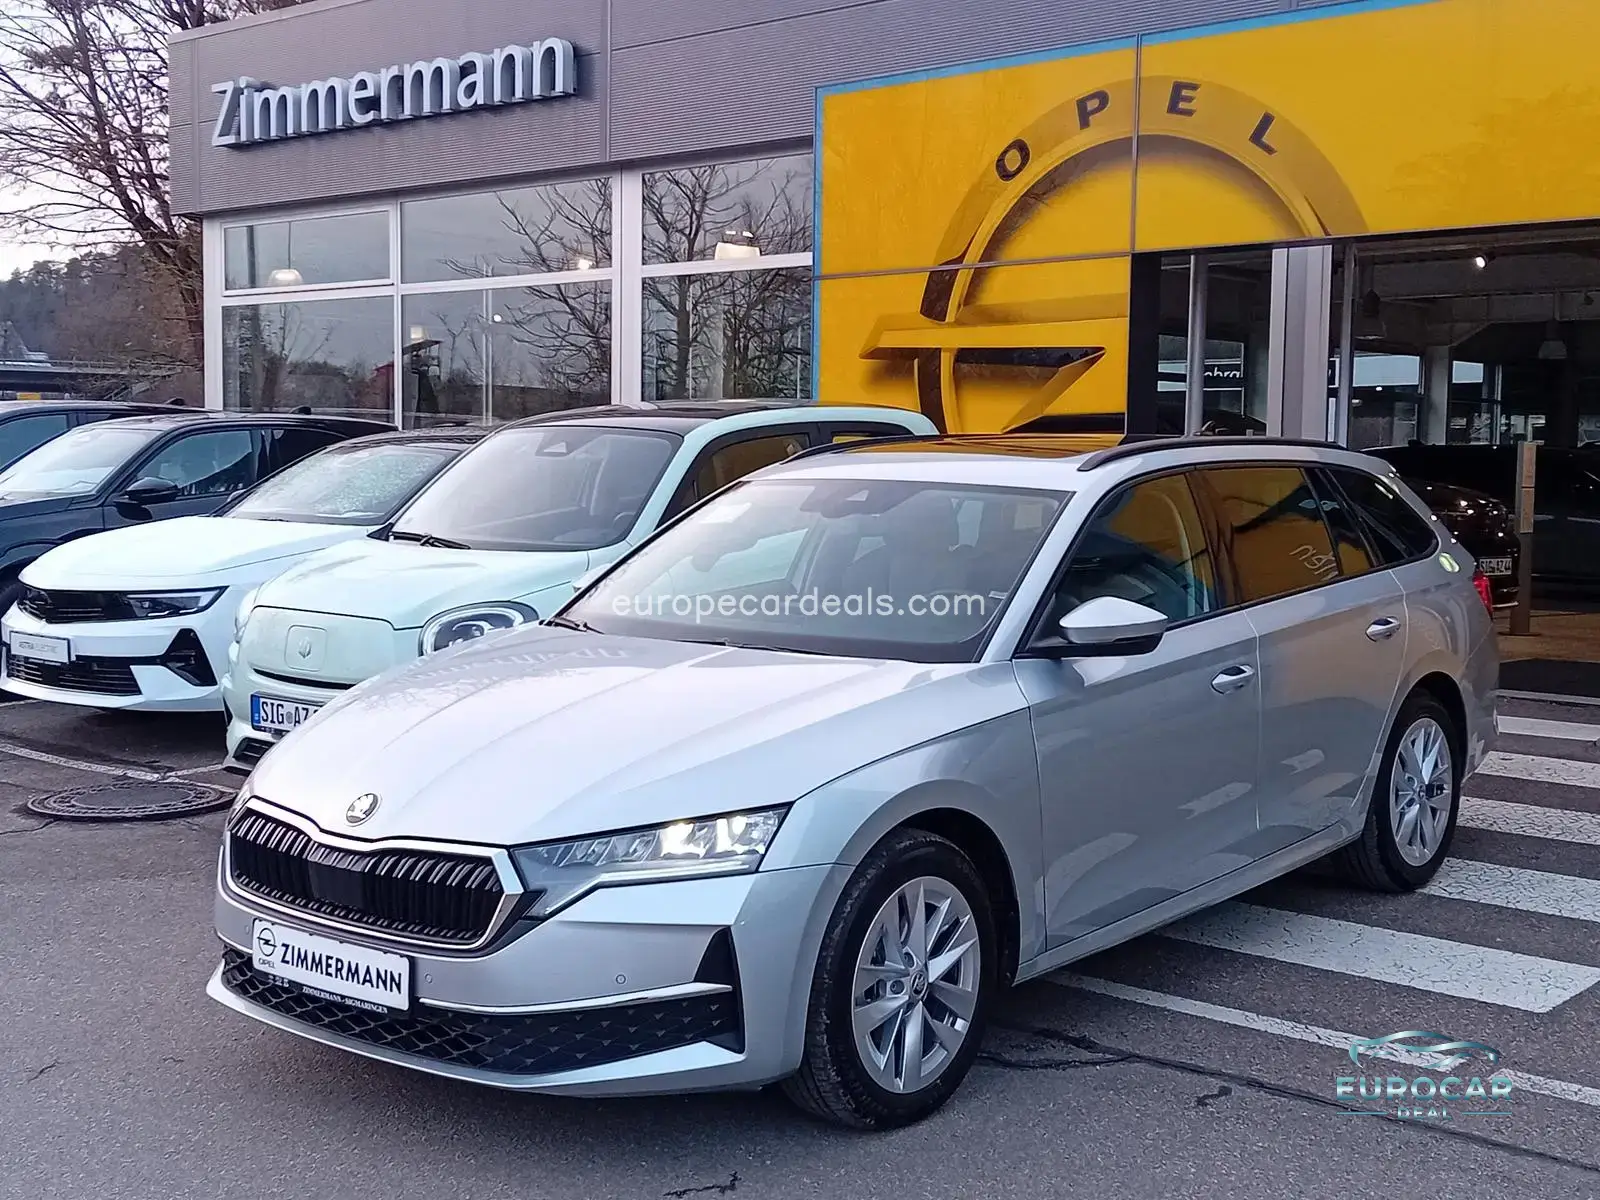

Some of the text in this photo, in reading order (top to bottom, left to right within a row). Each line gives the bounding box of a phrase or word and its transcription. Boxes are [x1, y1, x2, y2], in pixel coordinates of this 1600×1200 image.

[211, 37, 577, 147] Zimmermann
[995, 80, 1277, 182] OPEL
[261, 701, 284, 725] SIG
[258, 957, 275, 968] OPEL
[280, 943, 402, 995] ZIMMERMANN
